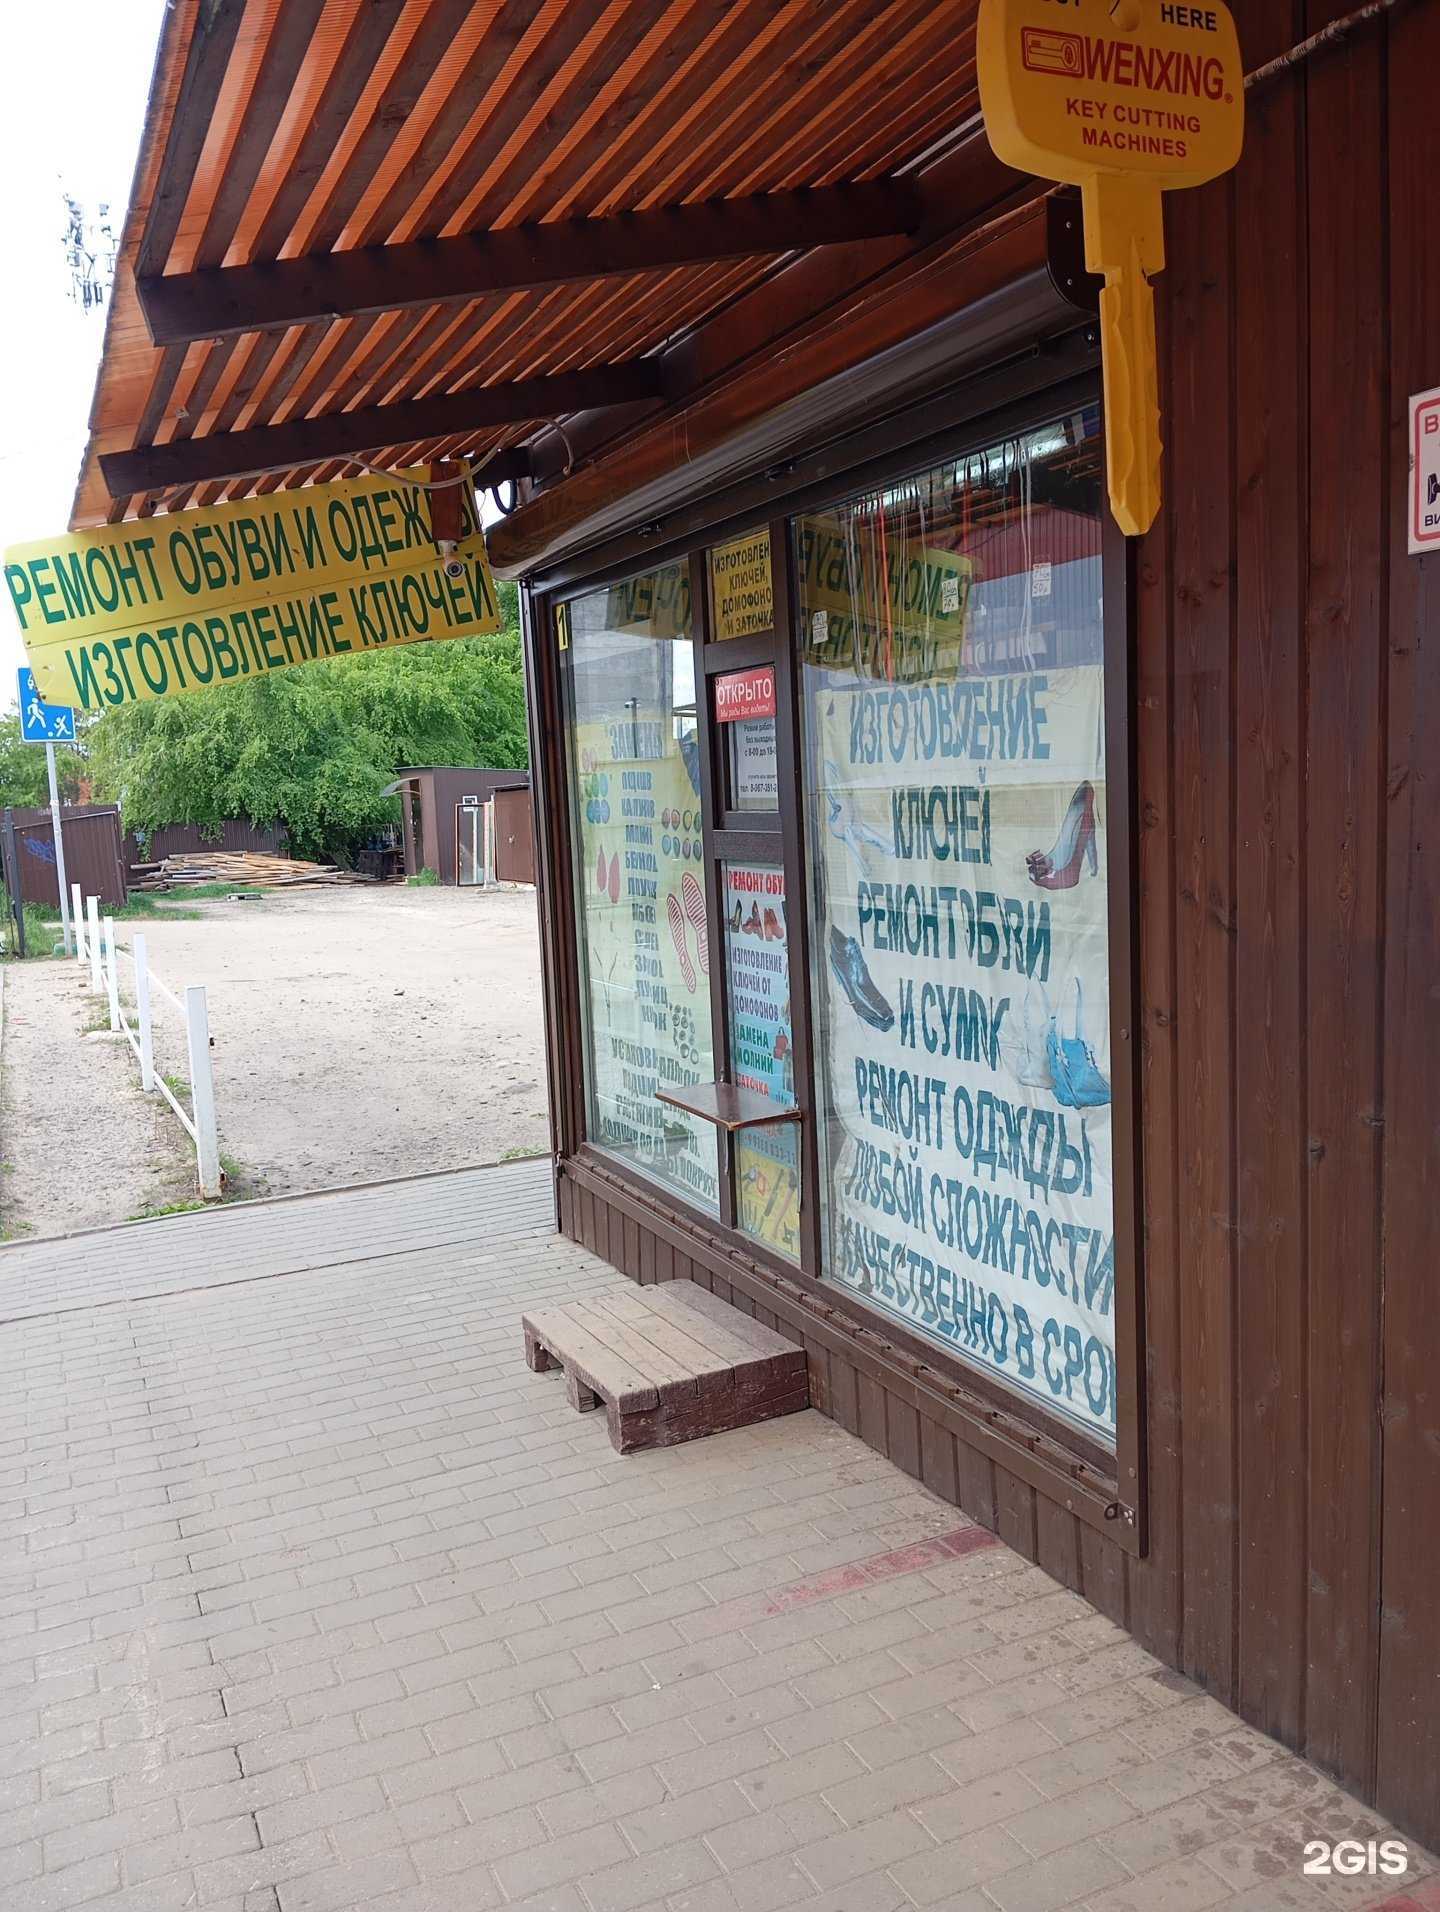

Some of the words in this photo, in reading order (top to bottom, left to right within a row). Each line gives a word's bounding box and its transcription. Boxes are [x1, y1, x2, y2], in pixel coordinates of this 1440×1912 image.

[1161, 3, 1217, 32] HERE
[1084, 36, 1225, 101] WENXING
[1066, 98, 1107, 119] KEY
[1113, 105, 1201, 133] CUTTING
[1082, 128, 1187, 157] MACHINES
[4, 536, 163, 629] РЕМОНТ
[169, 511, 295, 595] ОБУВИ
[293, 505, 328, 569] И
[328, 480, 481, 570] ОДЕЖЫ
[65, 592, 352, 709] ИЗГОТОВЛЕНИЕ
[354, 551, 495, 643] КЛЮЧЕЙ
[717, 677, 772, 705] ОТКРЫТО
[728, 870, 764, 893] РЕМОНТ
[857, 881, 957, 960] РЕМОНТ
[732, 946, 783, 974] ИЗГОТОВЛЕНИЕ
[734, 970, 761, 993] КЛЮЧЕЙ
[762, 977, 772, 996] ОТ
[735, 995, 779, 1022] ДОМОФОНОВ
[899, 978, 915, 1048] И
[735, 1048, 774, 1075] МОЛНИЙ
[855, 1057, 946, 1150] РЕМОНТ
[953, 1086, 1092, 1205] ОДЕЖДЫ
[844, 1139, 926, 1234] ЛЮБОЙ
[930, 1172, 1116, 1316] СЛОЖНОСТИ
[1013, 1304, 1036, 1380] В
